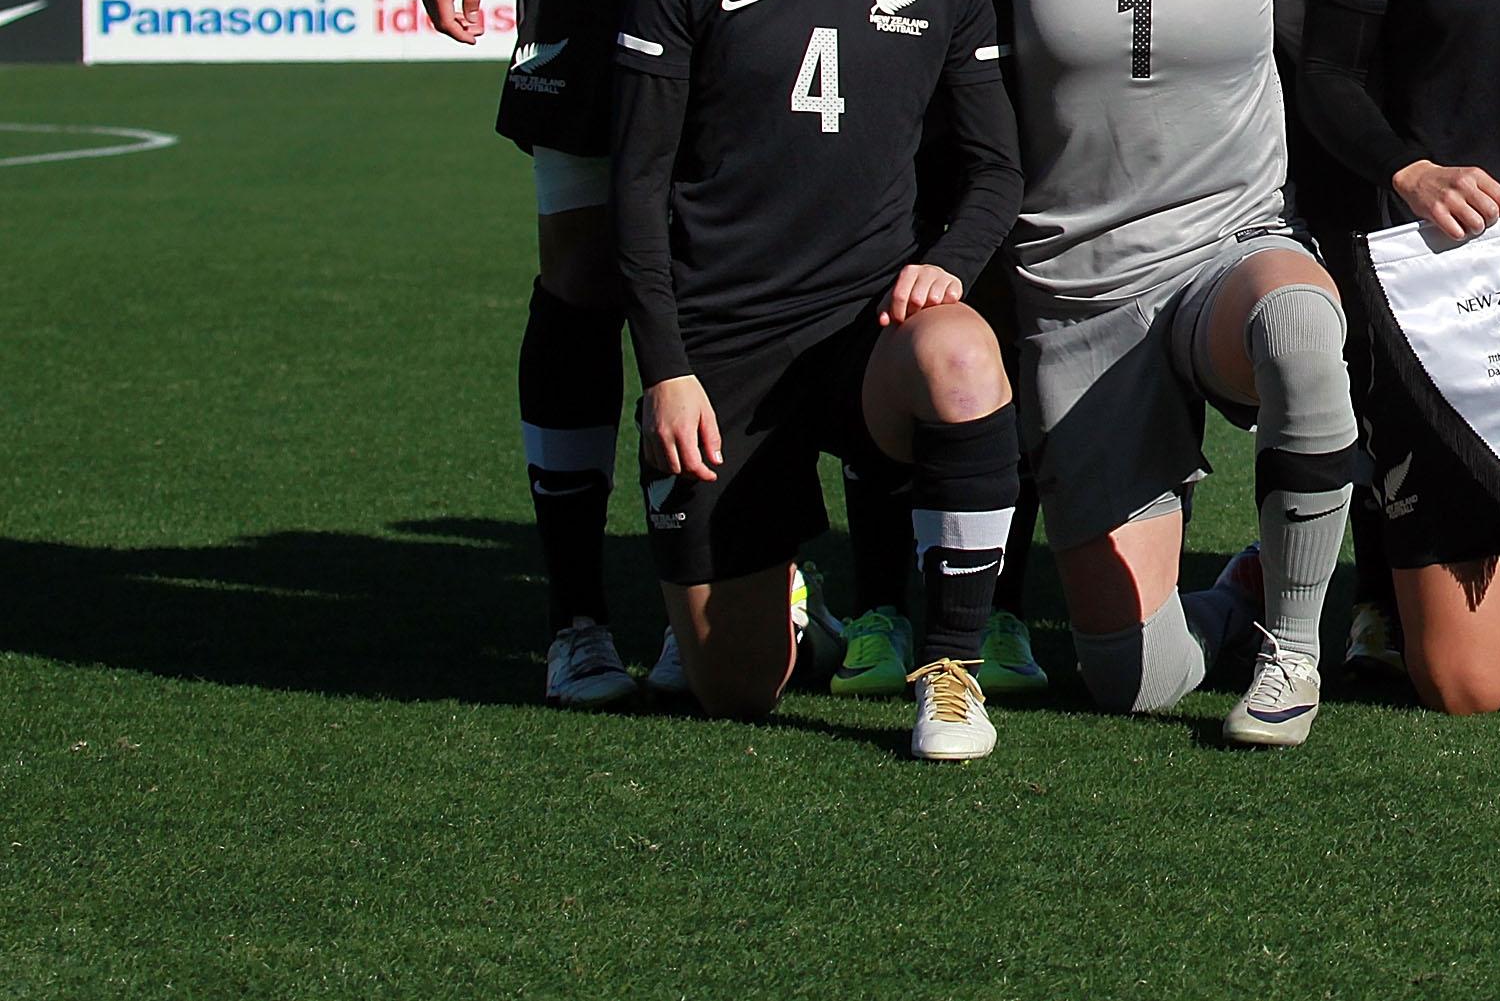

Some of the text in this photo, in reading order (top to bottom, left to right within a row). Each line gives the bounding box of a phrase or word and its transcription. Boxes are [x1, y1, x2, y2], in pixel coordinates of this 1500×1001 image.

[876, 23, 922, 36] FOOTBALL
[791, 27, 845, 133] 4
[1456, 293, 1492, 314] NEW
